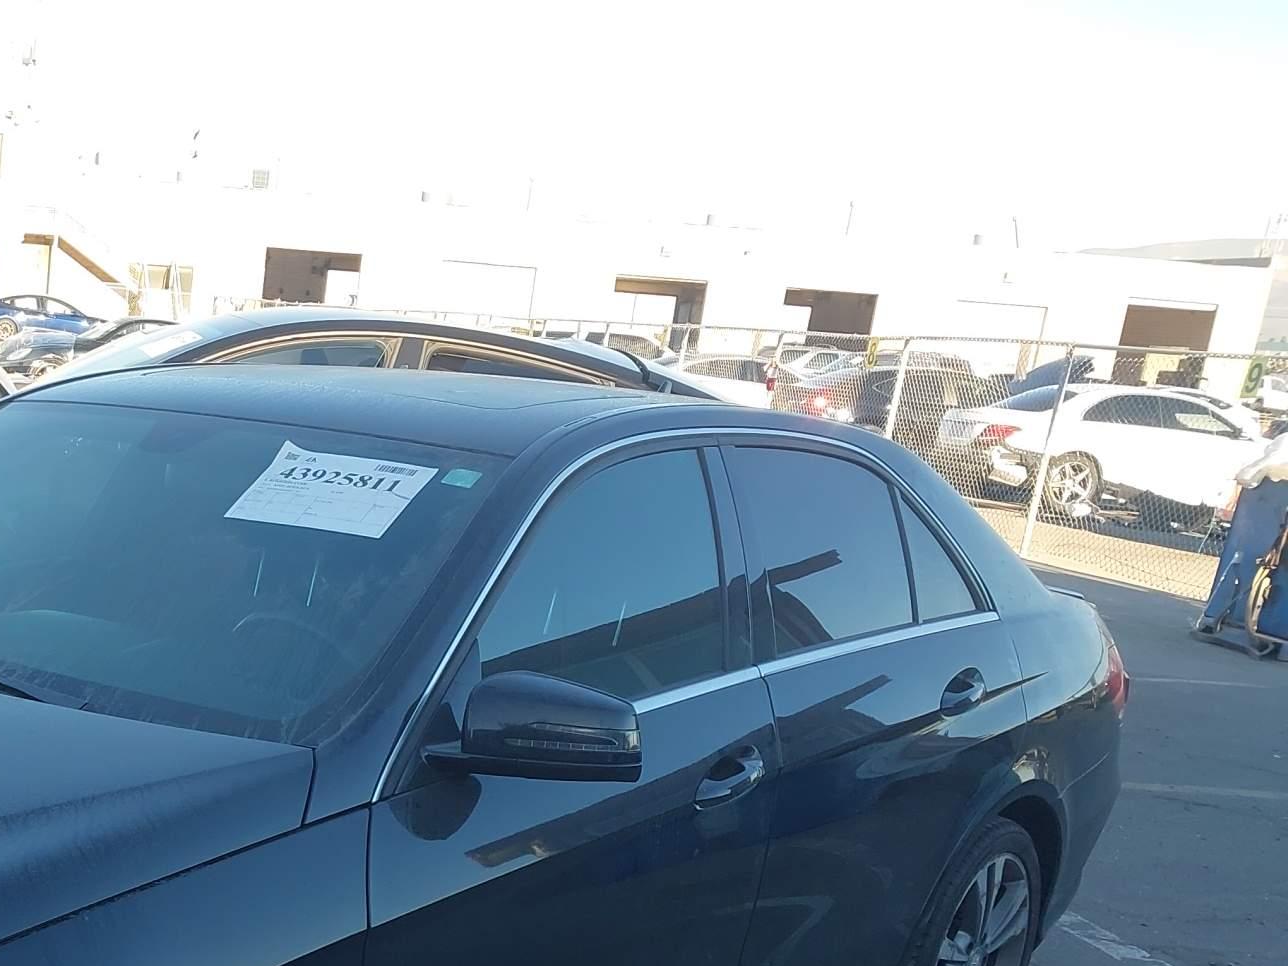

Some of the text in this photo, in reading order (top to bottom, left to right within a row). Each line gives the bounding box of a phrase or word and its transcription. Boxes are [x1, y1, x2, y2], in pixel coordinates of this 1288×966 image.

[867, 342, 877, 365] 8
[1244, 362, 1263, 394] 9
[279, 465, 401, 491] 43925811
